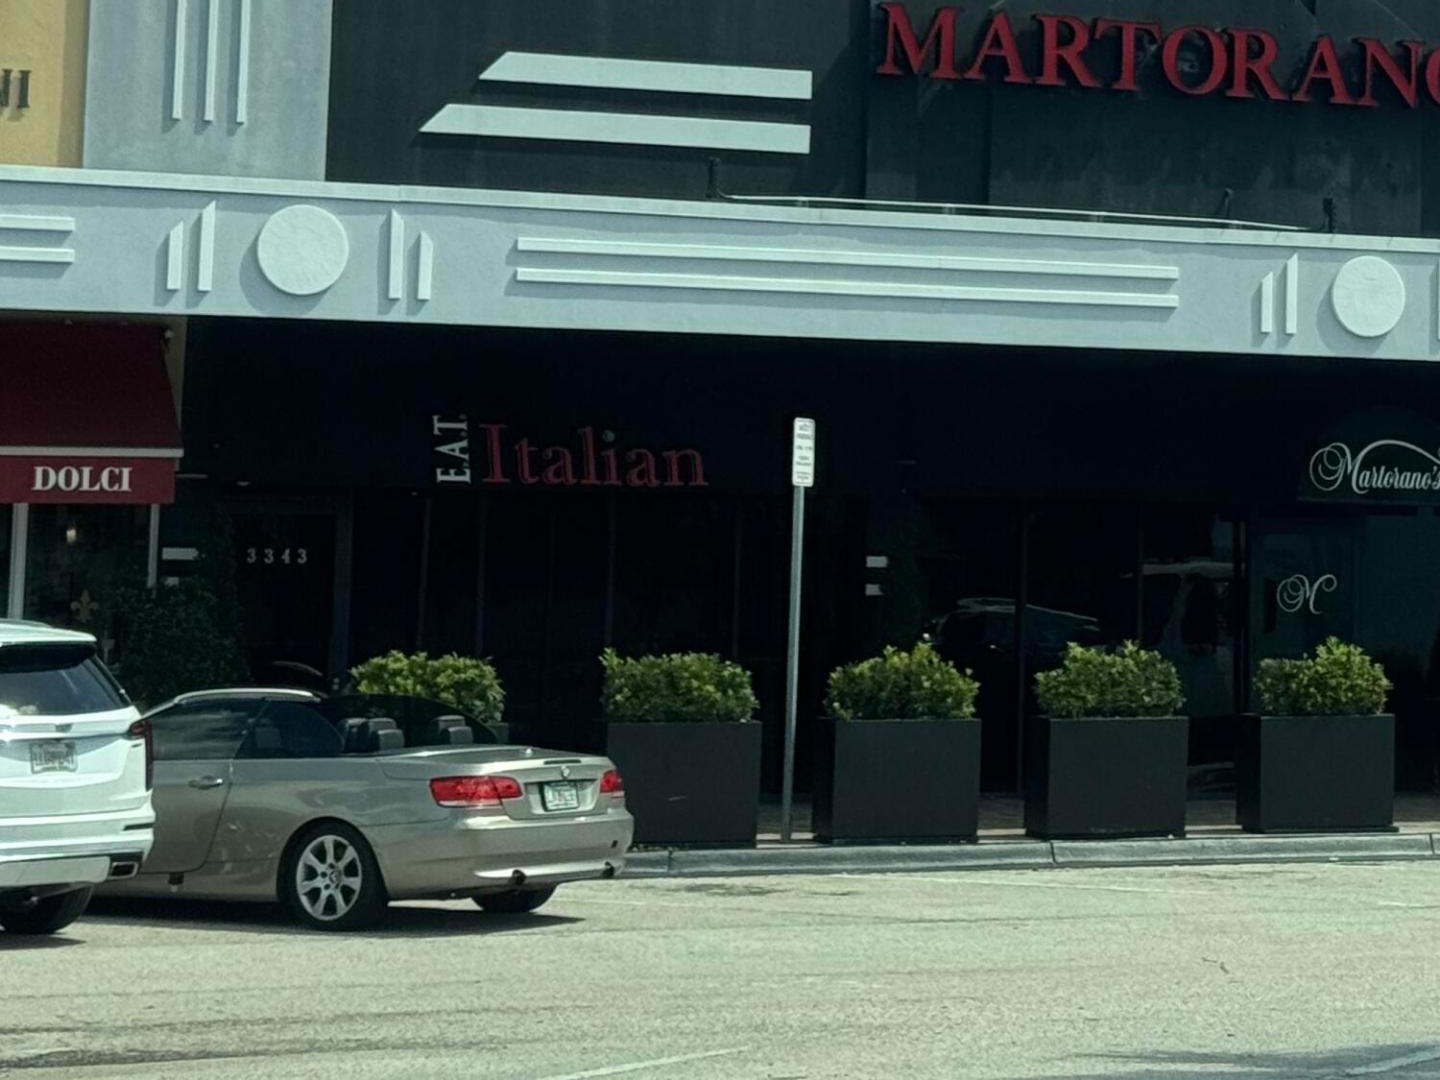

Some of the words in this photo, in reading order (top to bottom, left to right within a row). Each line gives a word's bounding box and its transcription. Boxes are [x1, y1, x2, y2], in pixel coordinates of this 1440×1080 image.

[479, 423, 709, 488] Italian
[32, 465, 132, 493] DOLCI
[246, 547, 308, 565] 3343
